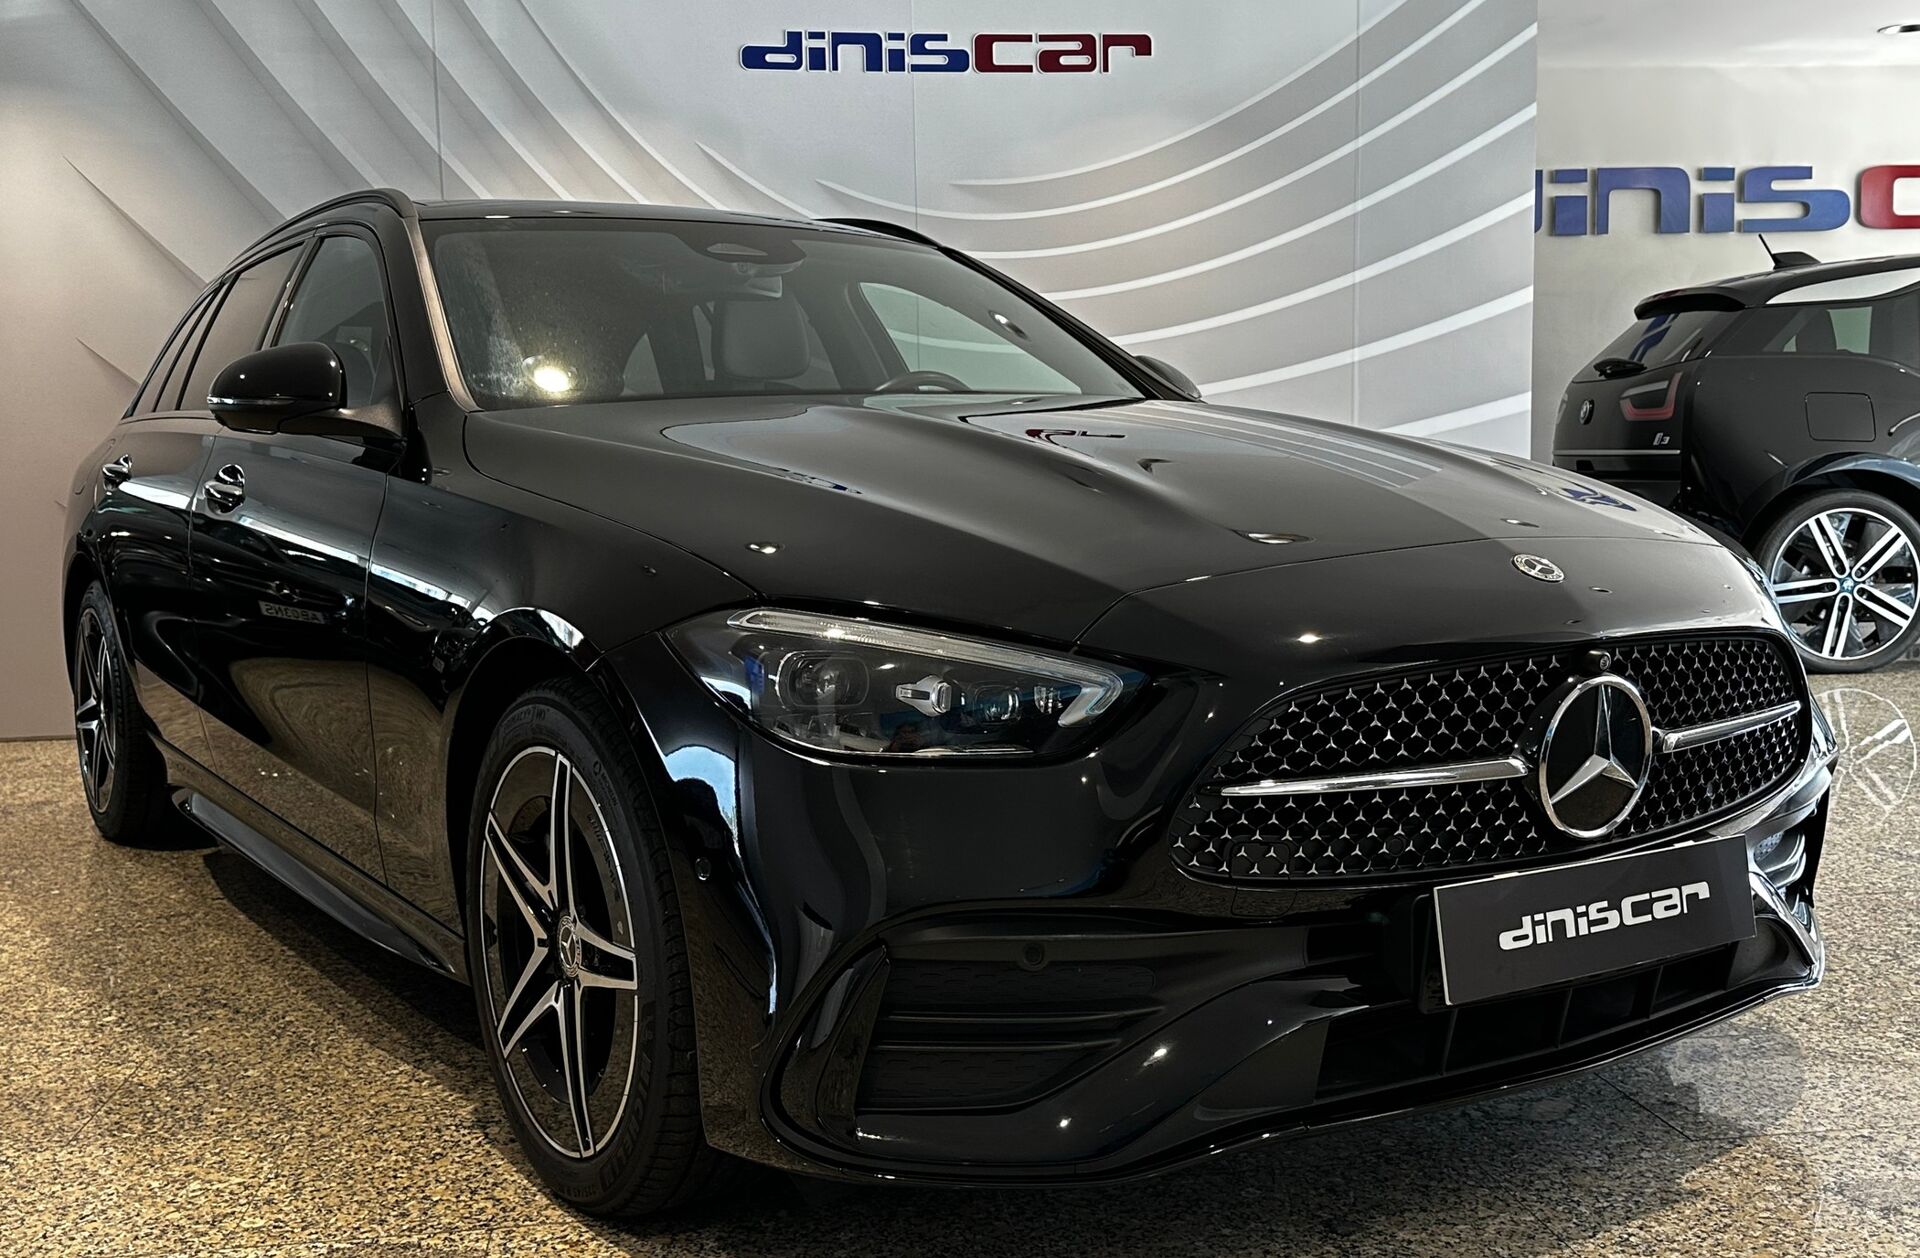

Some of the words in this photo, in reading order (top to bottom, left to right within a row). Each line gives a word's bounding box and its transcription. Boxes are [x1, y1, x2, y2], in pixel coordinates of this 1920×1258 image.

[740, 30, 1153, 74] diniscar
[1534, 164, 1920, 237] inisc
[1498, 881, 1711, 951] diniscar
